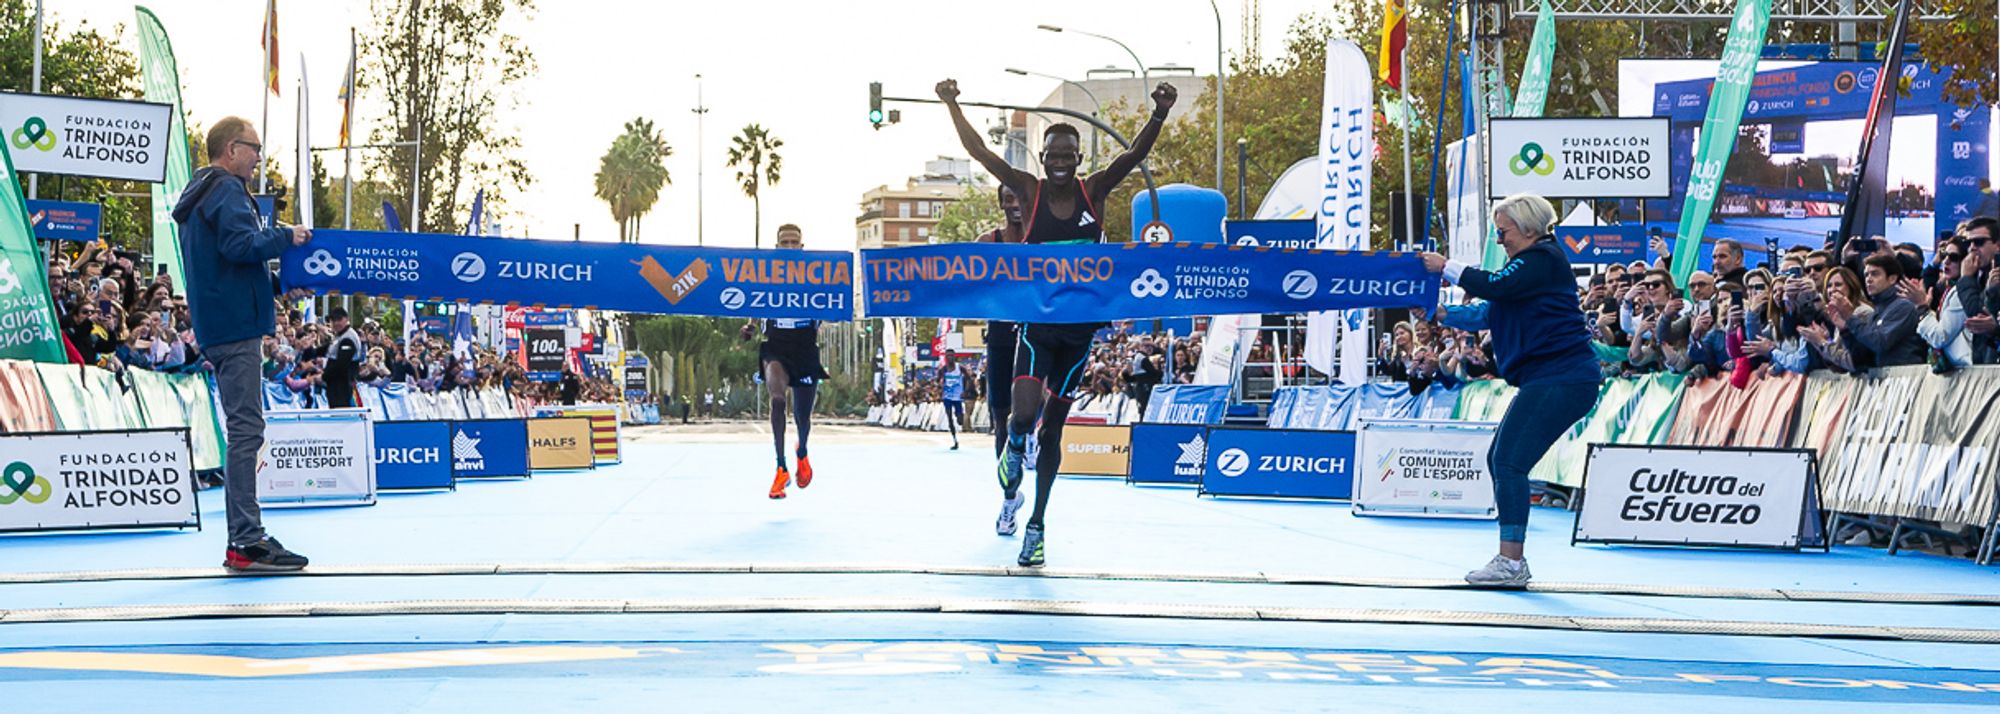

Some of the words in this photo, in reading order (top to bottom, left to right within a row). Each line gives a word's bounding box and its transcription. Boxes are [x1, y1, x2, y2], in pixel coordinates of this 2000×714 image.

[66, 115, 151, 131] FUNDACIÓN
[64, 128, 151, 148] TRINIDAD
[1562, 137, 1649, 146] FUNDACIÓN
[62, 145, 149, 164] ALFONSO
[1562, 150, 1650, 164] TRINIDAD
[1563, 166, 1651, 180] ALFONSO
[346, 246, 418, 257] FUNDACIÓN
[346, 257, 419, 270] TRINIDAD
[867, 256, 987, 281] TRINIDAD
[991, 256, 1114, 284] ALFONSO
[1176, 264, 1249, 275] FUNDACIÓN
[347, 269, 420, 281] ALFONSO
[498, 261, 592, 282] ZURICH
[721, 258, 850, 285] VALENCIA
[671, 270, 699, 297] 21K
[1175, 275, 1249, 288] TRINIDAD
[1330, 278, 1426, 296] ZURICH
[751, 292, 844, 309] ZURICH
[873, 290, 911, 303] 2023
[1174, 287, 1248, 300] ALFONSO
[533, 437, 576, 447] HALFS
[60, 451, 176, 466] FUNDACIÓN
[270, 446, 344, 458] COMUNITAT
[276, 459, 293, 469] DE
[296, 457, 354, 468] L'ESPORT
[1258, 455, 1345, 474] ZURICH
[1399, 456, 1473, 469] COMUNITAT
[60, 468, 179, 488] TRINIDAD
[1403, 468, 1420, 478] DE
[1423, 469, 1482, 480] L'ESPORT
[1629, 468, 1737, 496] Cultura
[1738, 483, 1765, 496] del
[64, 488, 181, 508] ALFONSO
[1620, 495, 1761, 525] Esfuerzo
